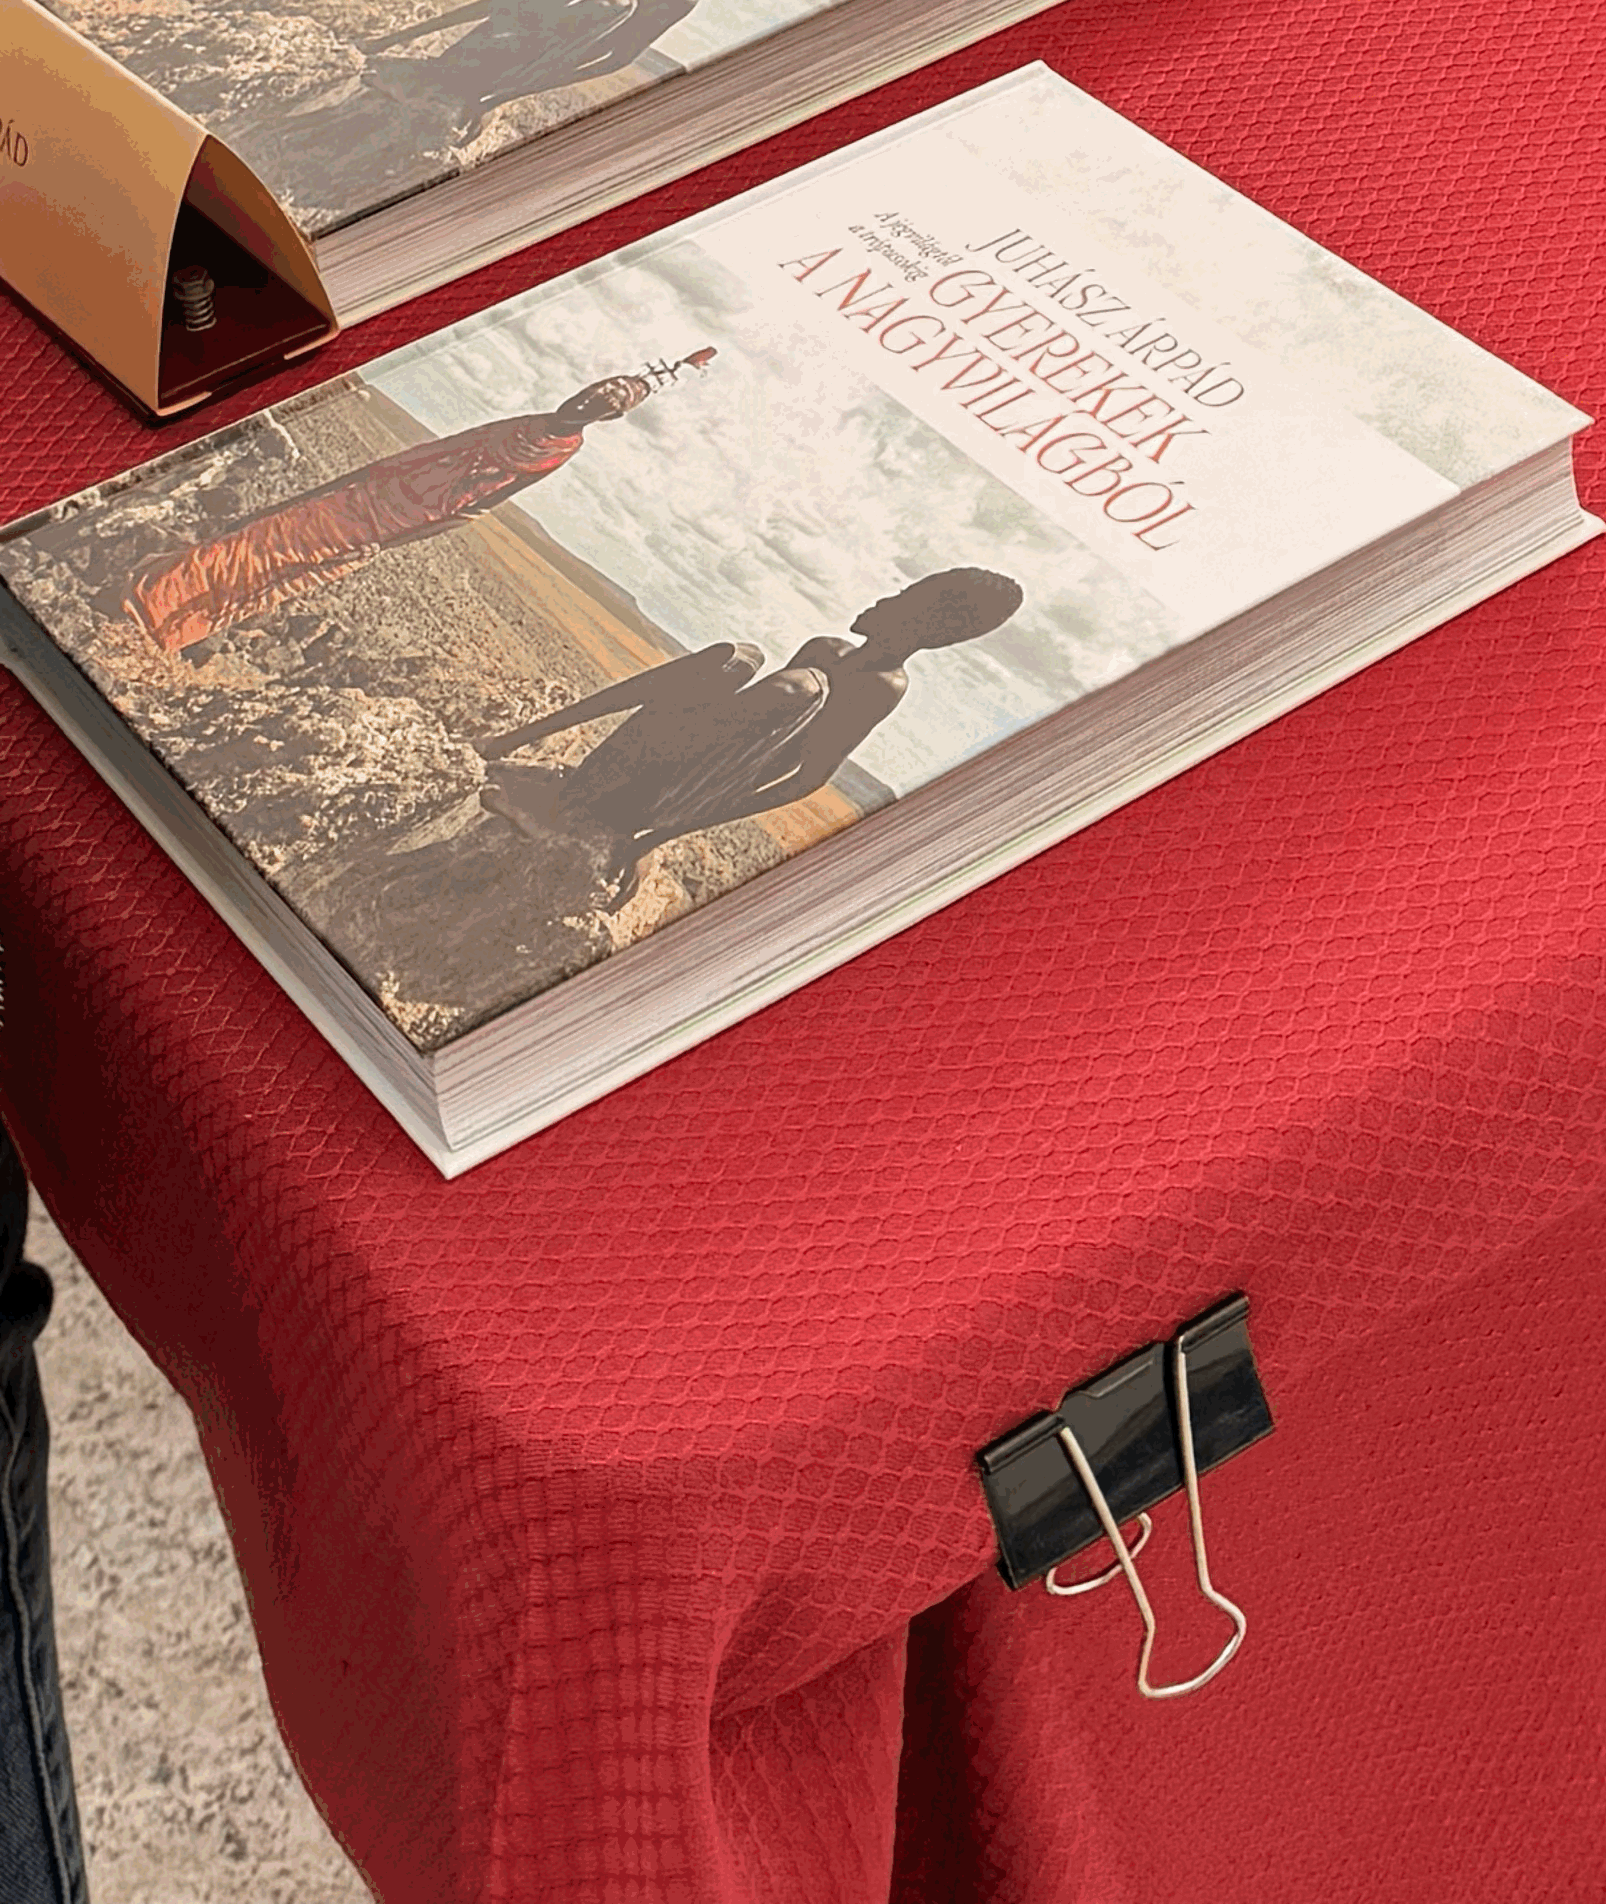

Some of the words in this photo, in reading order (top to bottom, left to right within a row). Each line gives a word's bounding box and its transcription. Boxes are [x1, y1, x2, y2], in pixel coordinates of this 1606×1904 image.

[0, 118, 29, 167] ÁD
[777, 247, 843, 283] A
[814, 268, 1197, 552] NAGYVILÁGBÓL
[929, 269, 1212, 464] GYEREKEK
[966, 228, 1132, 330] JUHÁSZ
[1098, 317, 1245, 408] ÁRPÁD
